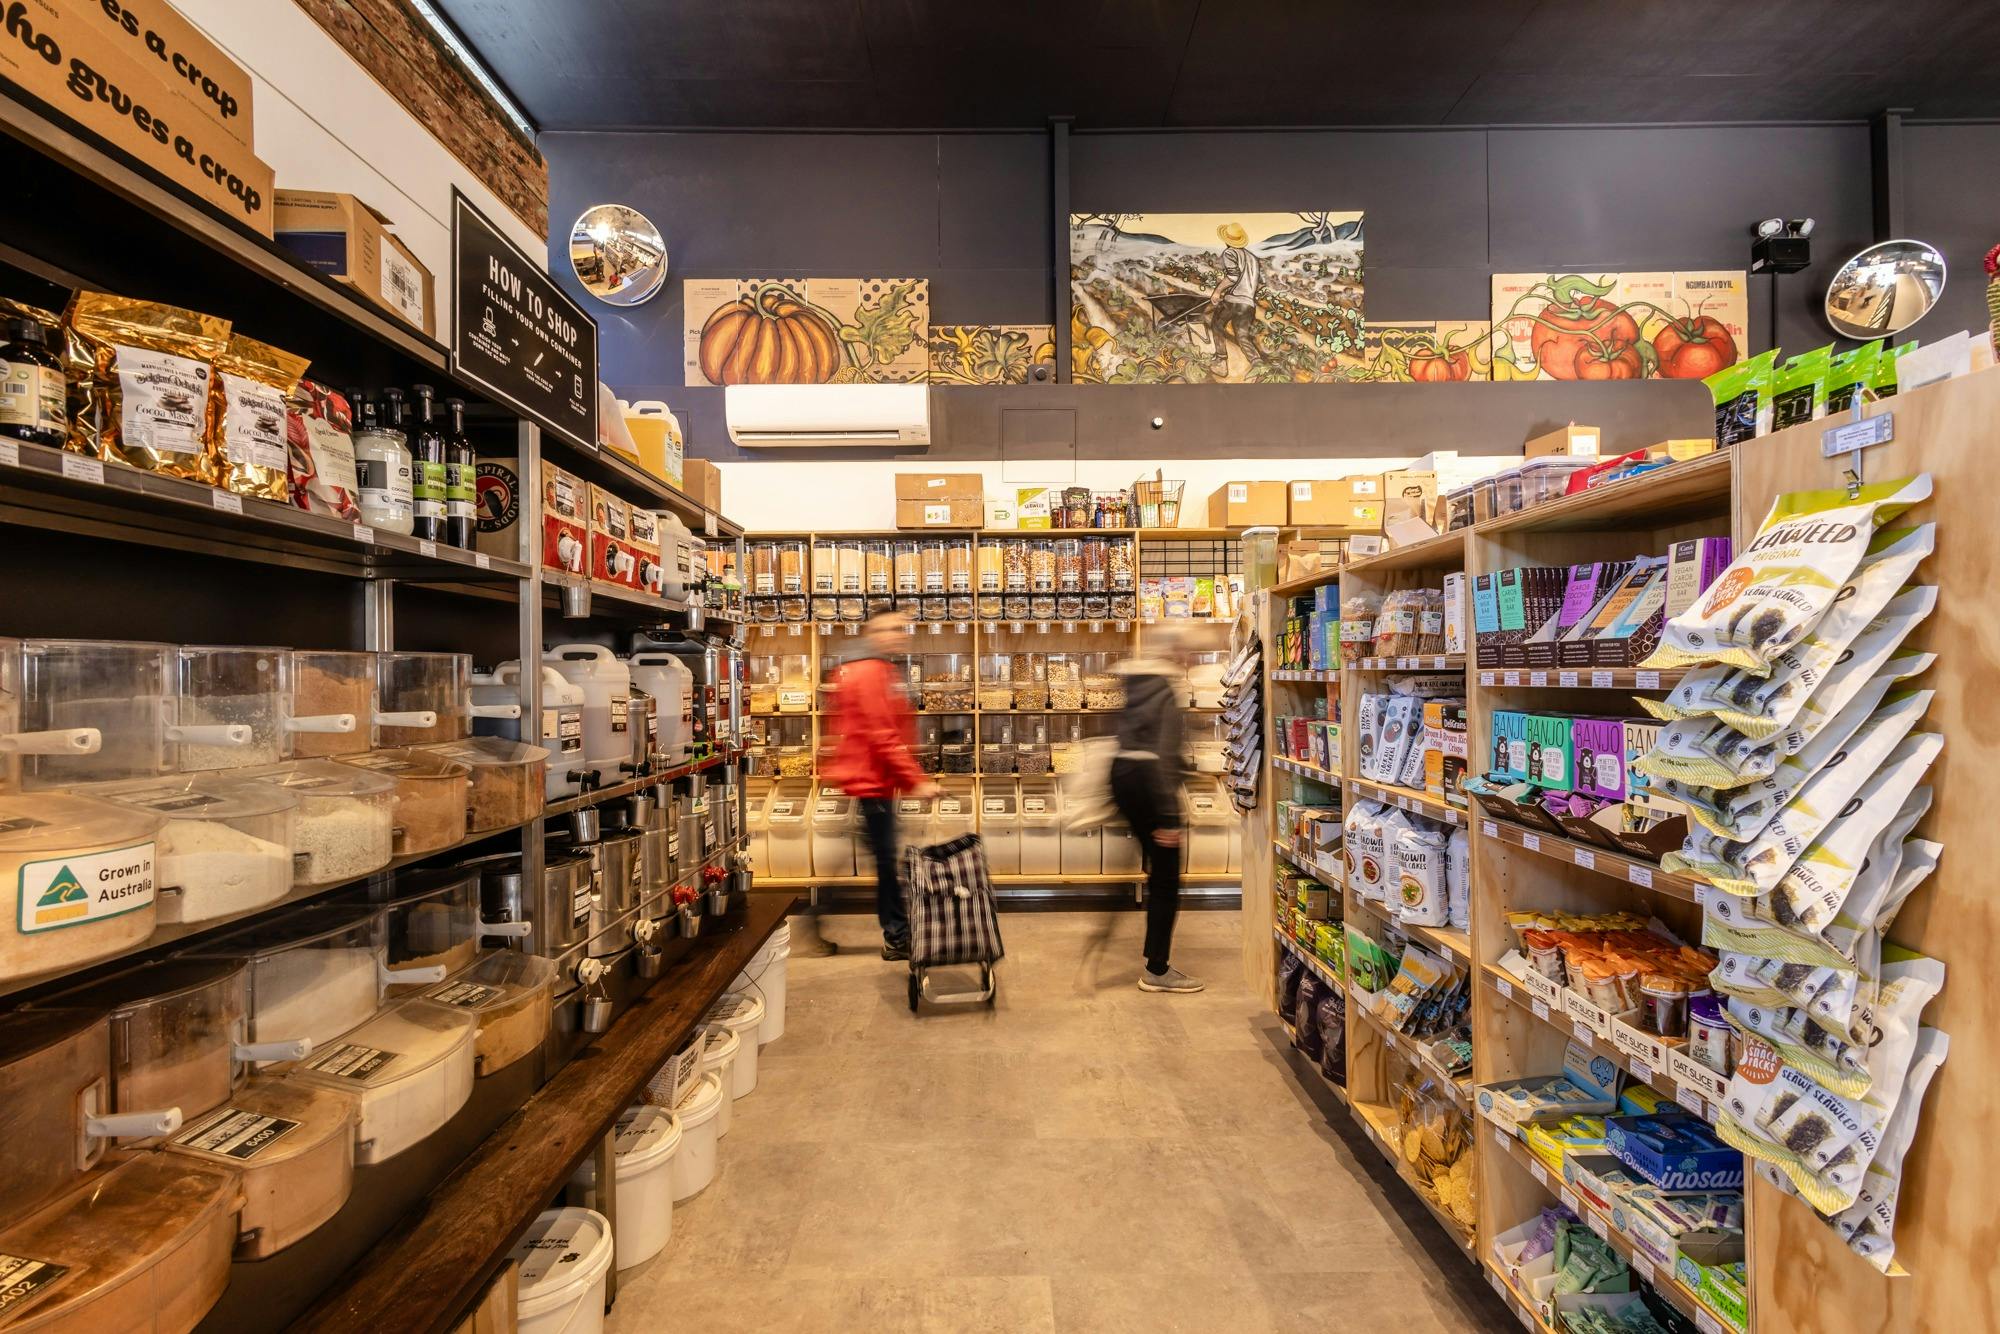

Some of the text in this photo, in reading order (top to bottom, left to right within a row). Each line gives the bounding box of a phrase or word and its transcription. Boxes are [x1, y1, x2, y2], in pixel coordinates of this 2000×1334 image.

[145, 30, 238, 119] a crap
[0, 1, 262, 214] ho gives a crap
[489, 255, 578, 348] HOW TO SHOP
[482, 283, 582, 370] FILLING YOUR OWN CONTAINER
[135, 403, 190, 422] Cocoa Mass
[238, 424, 262, 438] Cocoa
[477, 466, 517, 489] SPIRAL
[494, 494, 520, 528] FOODS
[1749, 523, 1857, 552] EAWEED
[1753, 549, 1801, 562] ORIGINAL
[1743, 588, 1771, 597] SEAWE
[1773, 588, 1814, 612] SEAWEED
[1459, 735, 1467, 744] Ric
[1527, 719, 1564, 748] BANJO
[1575, 722, 1620, 754] BANJO
[1626, 727, 1657, 752] BAN
[1448, 743, 1463, 755] Crisps
[1400, 852, 1426, 862] ROWN
[1408, 862, 1427, 870] CAKES
[99, 859, 151, 882] Grown in
[1793, 865, 1823, 893] AWEED
[98, 878, 152, 903] Australia
[1526, 973, 1550, 993] OAT SLICE
[1567, 997, 1596, 1020] OAT SLICE
[1615, 1029, 1649, 1056] OAT SLICE
[1694, 1045, 1708, 1053] OAT
[1748, 1044, 1779, 1063] SNACK
[1692, 1051, 1712, 1060] SLICE
[1748, 1056, 1776, 1074] PACKS
[1673, 1059, 1688, 1073] OAT
[1690, 1068, 1713, 1088] SLICE
[1781, 1069, 1813, 1093] SEAWE
[1812, 1089, 1858, 1132] SEAWEED
[245, 1129, 274, 1148] 6400
[1605, 1137, 1623, 1160] Blue
[1624, 1152, 1665, 1190] Dinosaur
[1661, 1165, 1744, 1191] inosau
